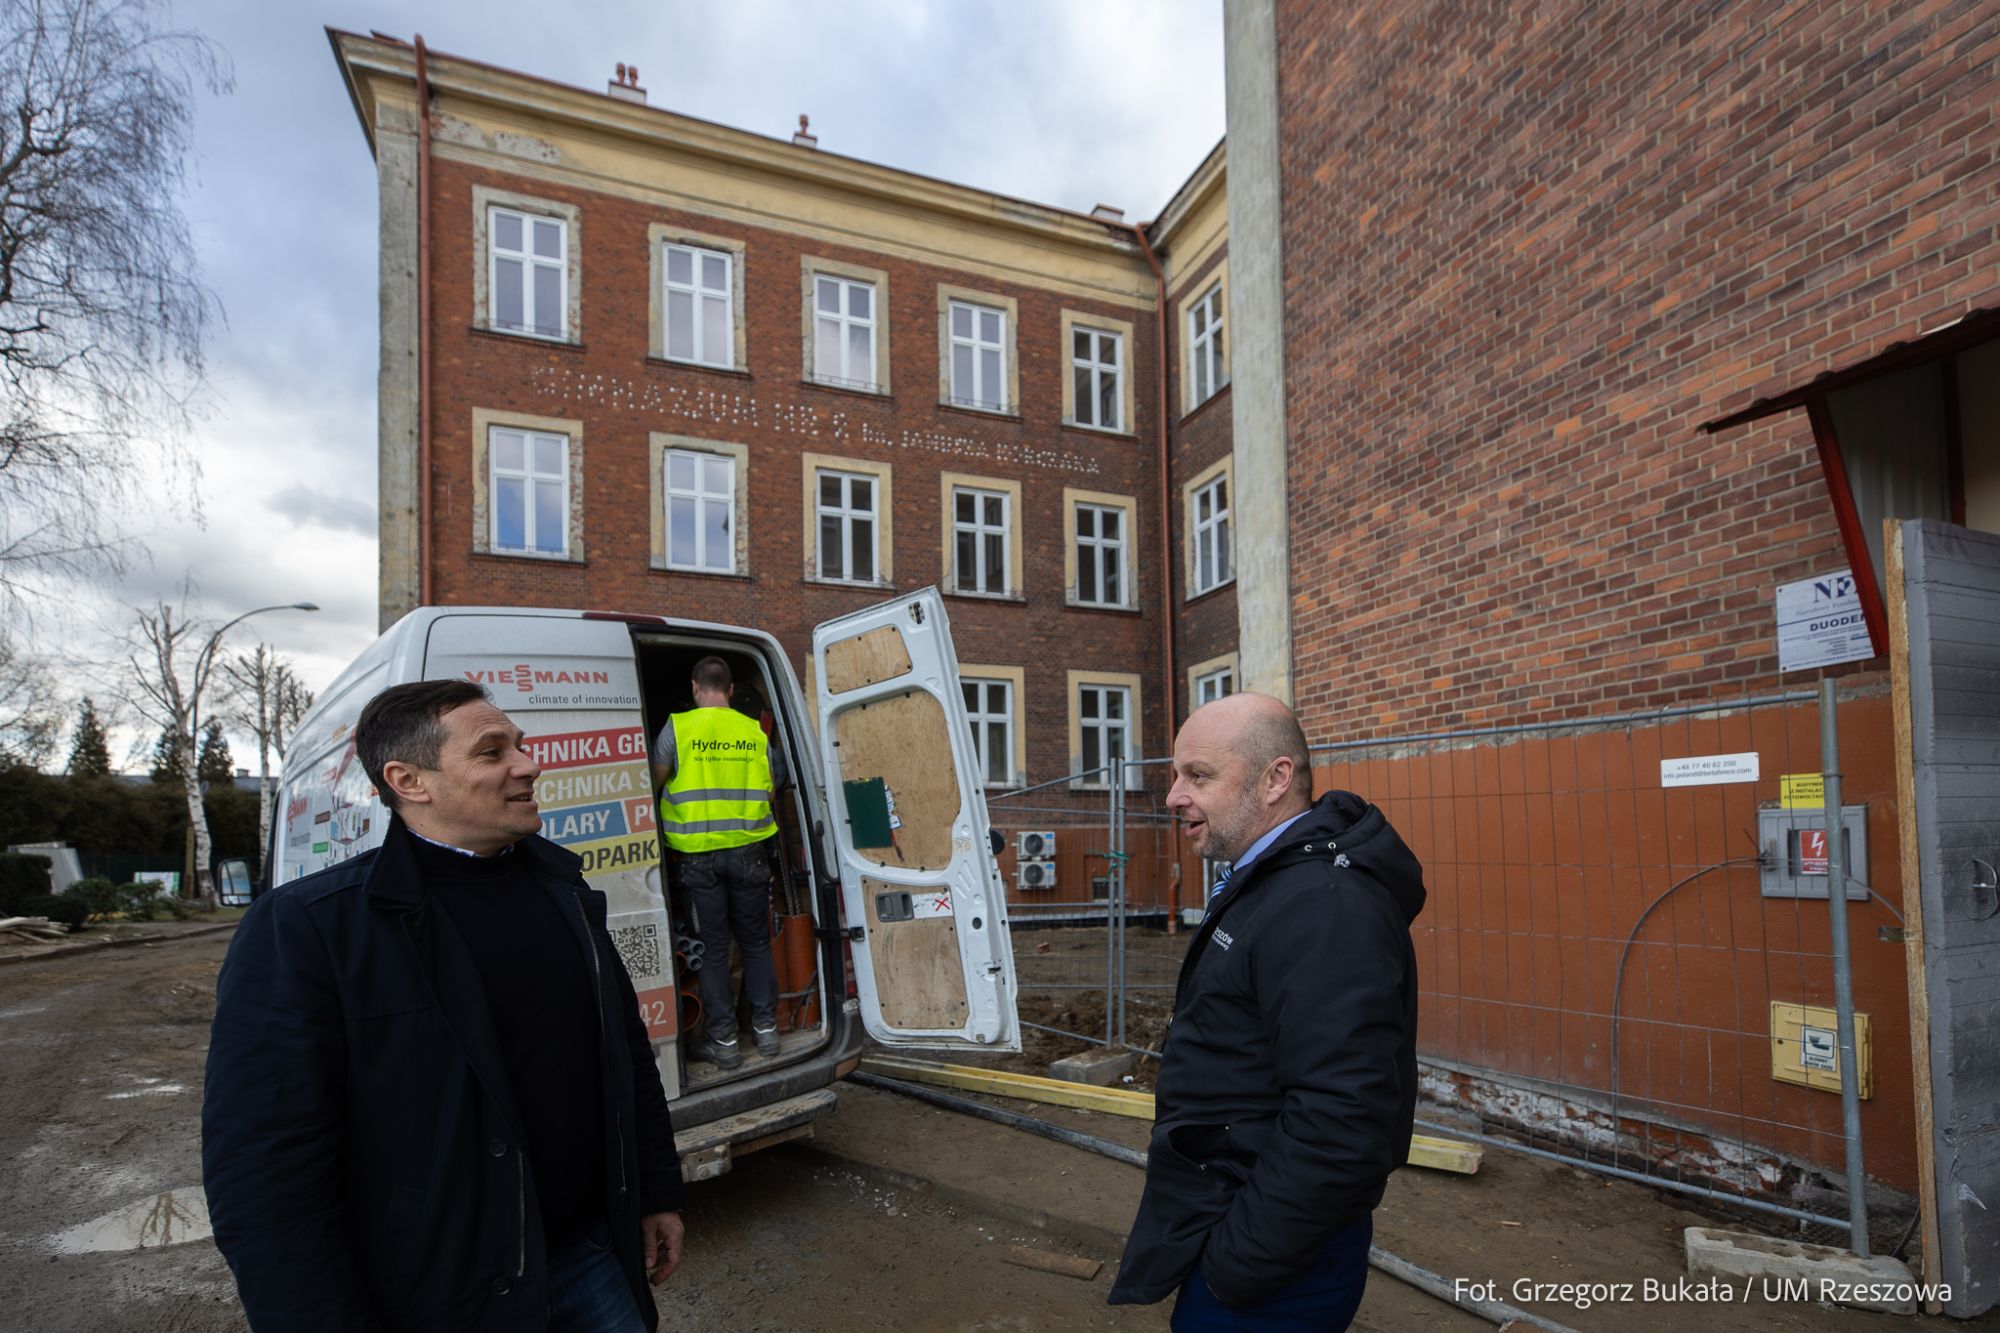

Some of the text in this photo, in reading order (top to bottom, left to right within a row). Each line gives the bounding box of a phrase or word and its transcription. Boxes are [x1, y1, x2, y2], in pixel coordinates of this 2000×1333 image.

[464, 664, 609, 692] VIESSMANN
[528, 694, 639, 705] climate of innovation
[692, 739, 757, 752] Hydro-Met
[580, 839, 660, 872] OPARK
